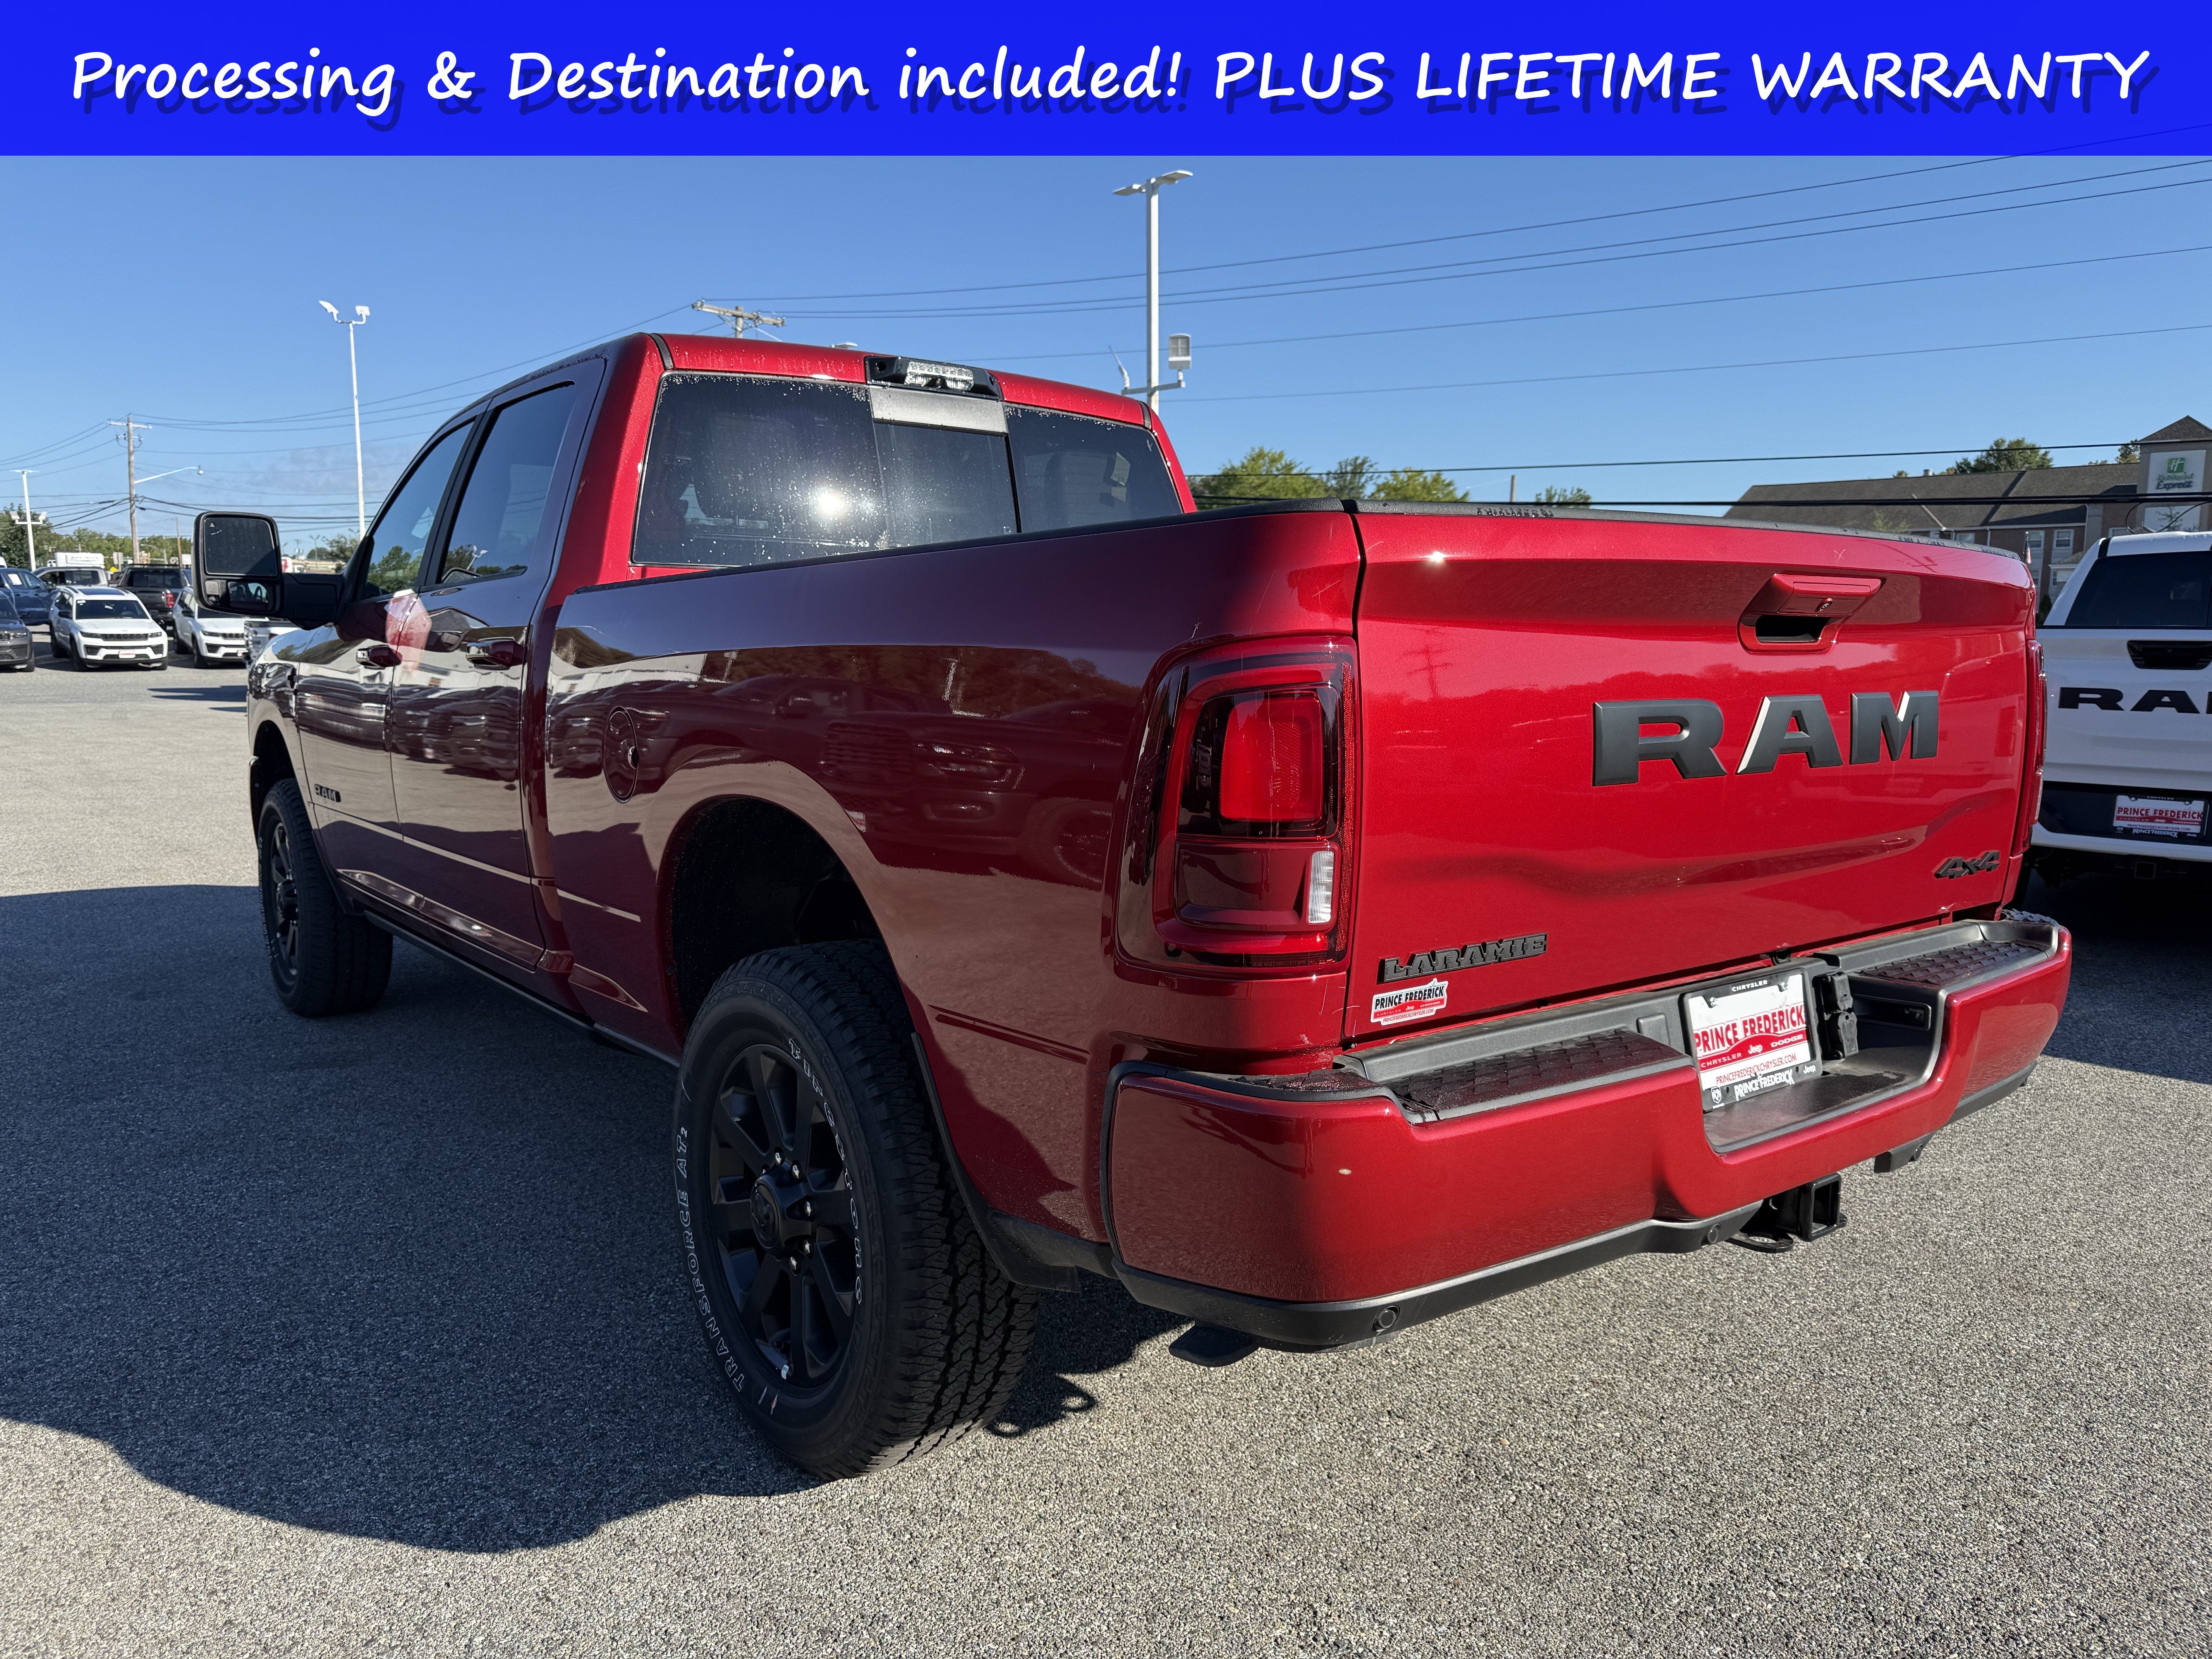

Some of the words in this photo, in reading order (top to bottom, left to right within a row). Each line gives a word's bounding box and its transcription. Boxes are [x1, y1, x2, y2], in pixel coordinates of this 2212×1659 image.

[2058, 687, 2212, 714] RA
[1592, 690, 1939, 787] RAM
[314, 785, 337, 802] RAM
[2118, 807, 2150, 816] PRINCE
[2154, 809, 2203, 819] FREDERICK
[1377, 933, 1548, 984] LARAMIE
[1375, 994, 1402, 1010] PRINCE
[1405, 986, 1444, 1002] FREDERICK
[1732, 980, 1768, 992] CHRYSLER
[1694, 1023, 1739, 1053] PRINCE
[1742, 1004, 1805, 1037] FREDERICK
[1701, 1052, 1742, 1068] CHRYSLER
[1748, 1044, 1763, 1054] Jeep
[1771, 1034, 1804, 1048] DODGE
[1716, 1053, 1797, 1085] PRINCEFREDERICKCHRYSLER.COM
[1734, 1079, 1760, 1101] PRINCE
[1759, 1069, 1795, 1089] FREDERICK
[1803, 1064, 1816, 1074] Jeep
[677, 1188, 745, 1392] TRANSFORCE
